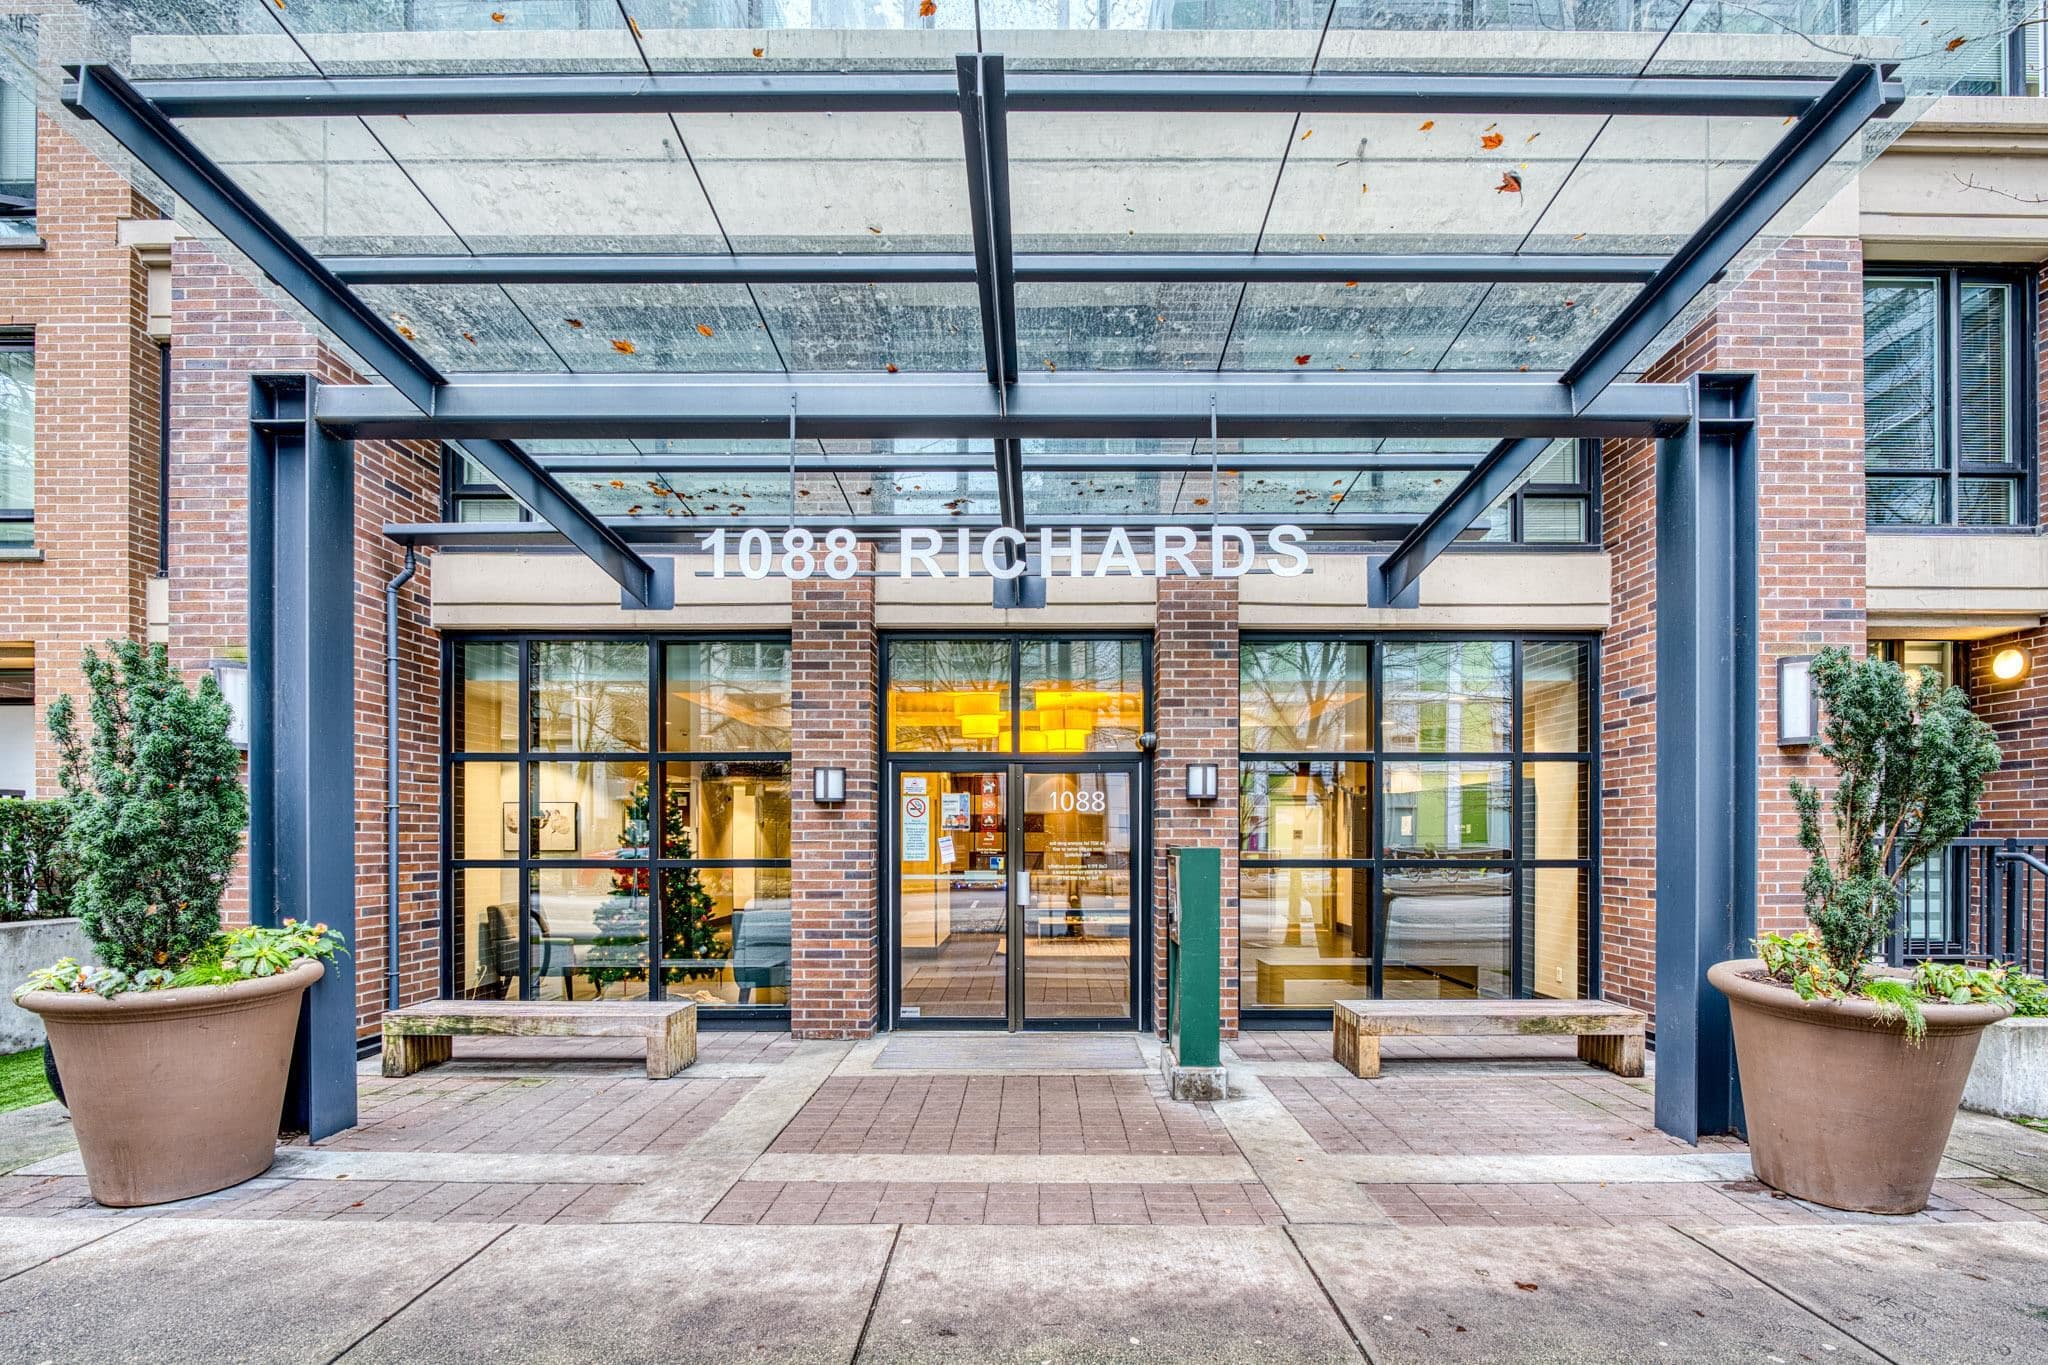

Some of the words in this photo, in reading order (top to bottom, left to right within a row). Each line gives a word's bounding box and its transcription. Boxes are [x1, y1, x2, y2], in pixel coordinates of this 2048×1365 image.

[701, 527, 858, 580] 1088
[900, 525, 1309, 579] RICHARDS
[1049, 790, 1106, 812] 1088
